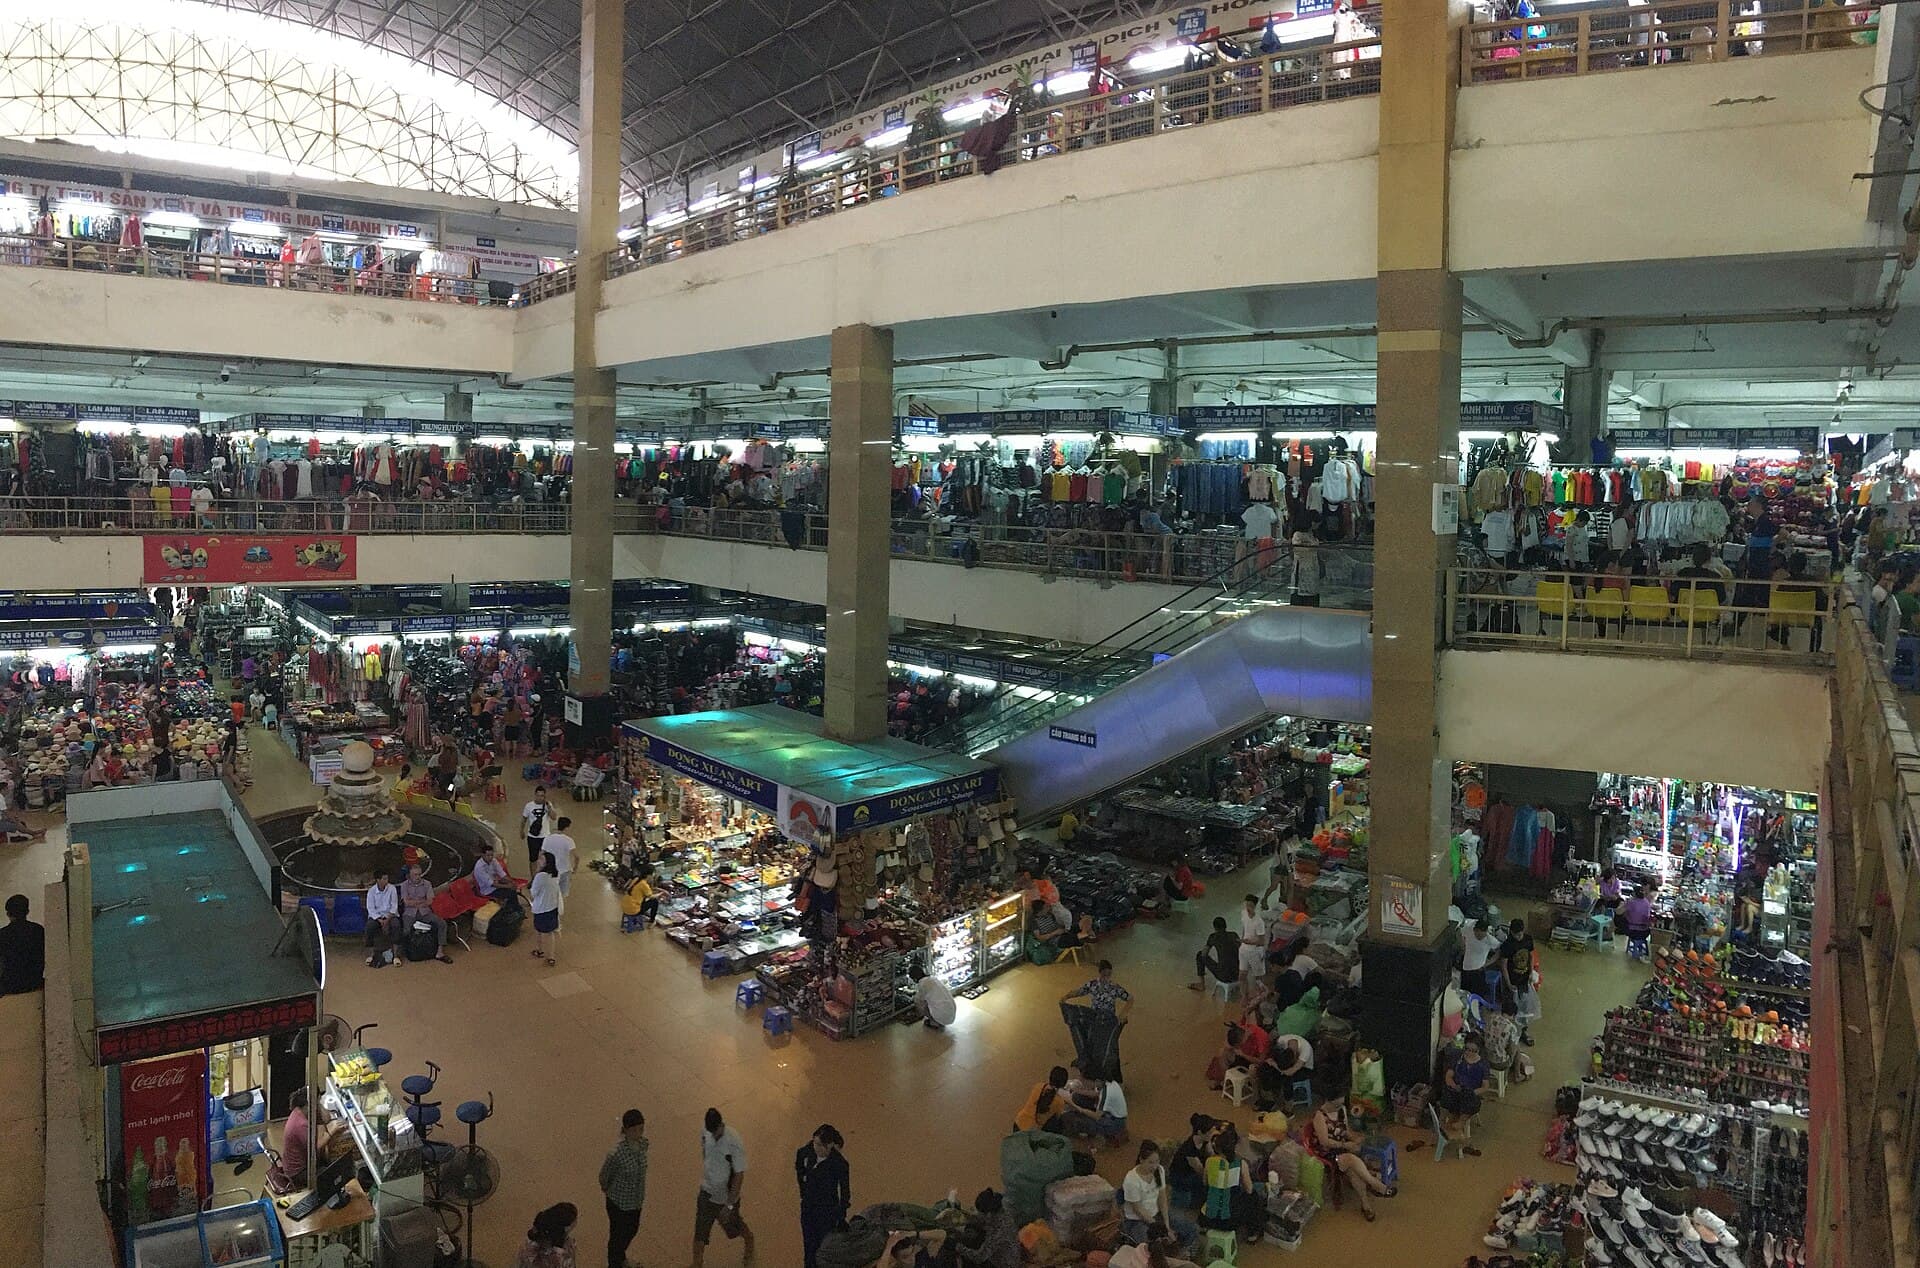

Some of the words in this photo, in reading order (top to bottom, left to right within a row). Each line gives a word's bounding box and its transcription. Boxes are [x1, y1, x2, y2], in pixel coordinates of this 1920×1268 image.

[858, 114, 879, 126] TY
[56, 186, 104, 203] TH
[738, 776, 763, 792] ART
[963, 776, 984, 791] ART
